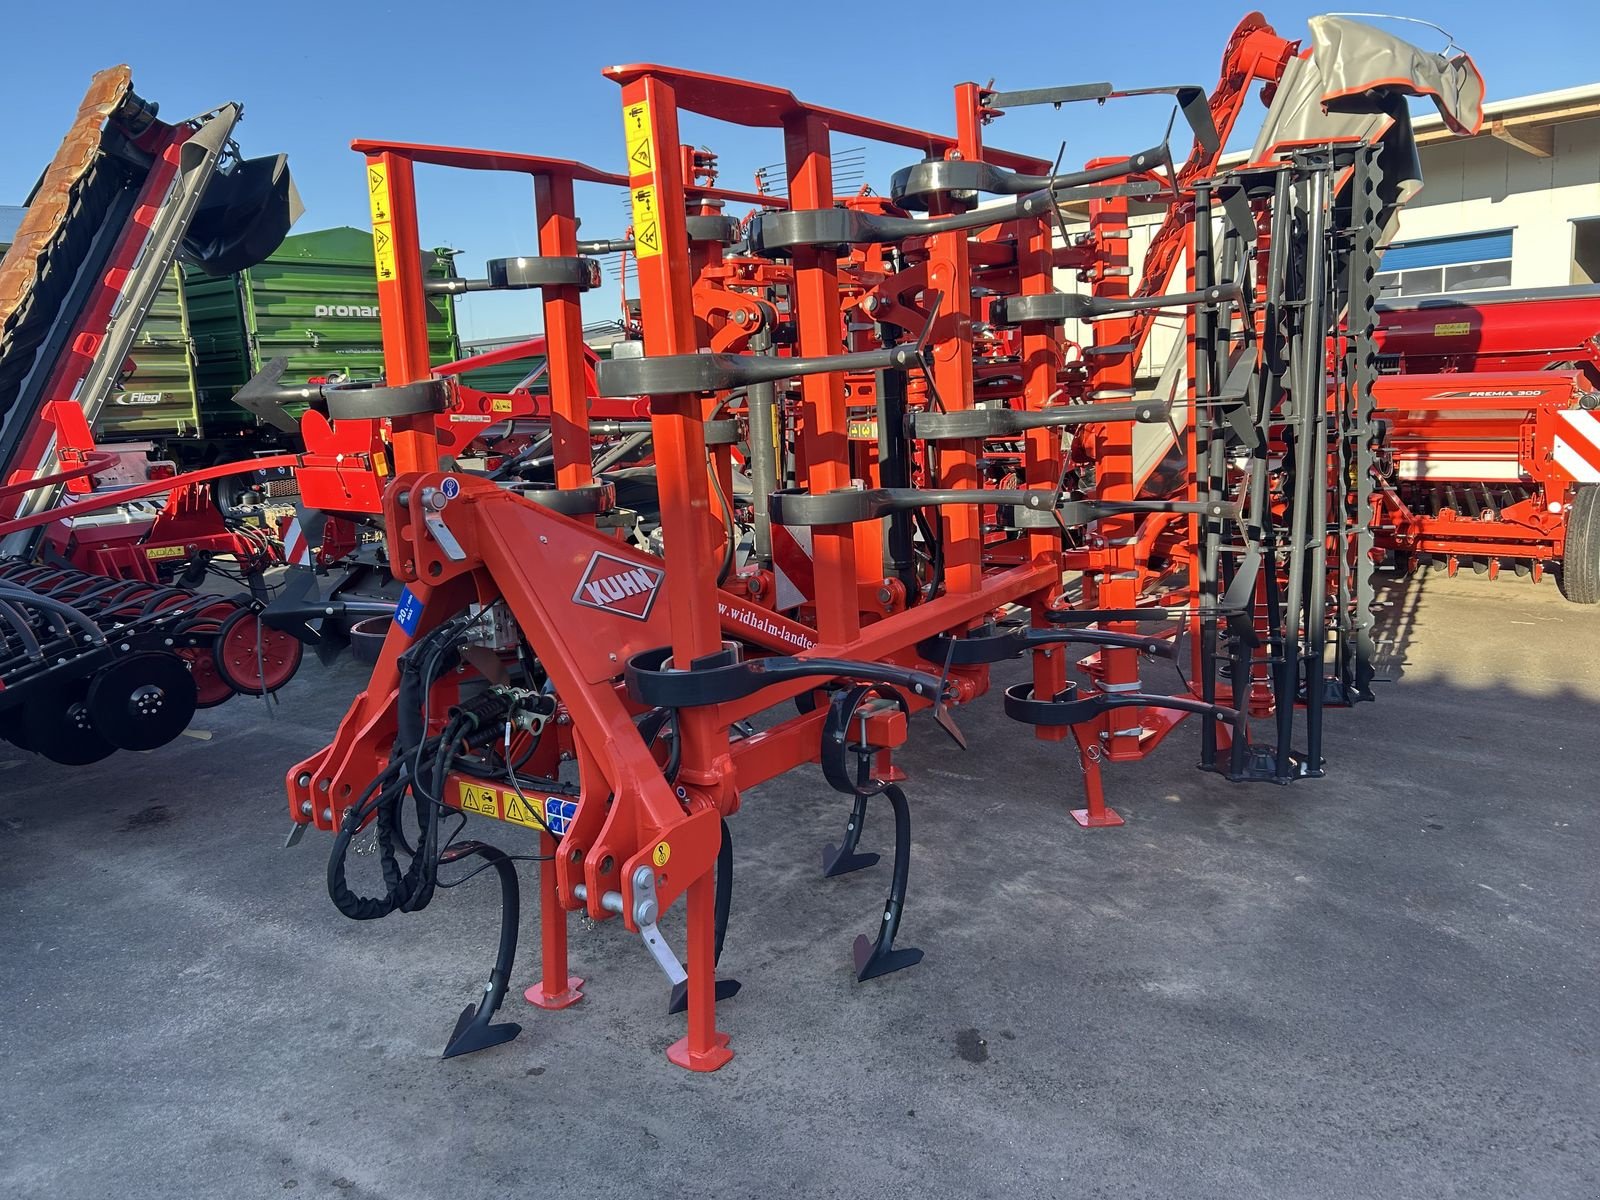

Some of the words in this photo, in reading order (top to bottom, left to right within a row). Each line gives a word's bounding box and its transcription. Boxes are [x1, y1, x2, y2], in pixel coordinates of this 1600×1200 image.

[130, 392, 162, 405] Fliegl
[584, 567, 656, 607] KUHN
[398, 608, 407, 625] 20
